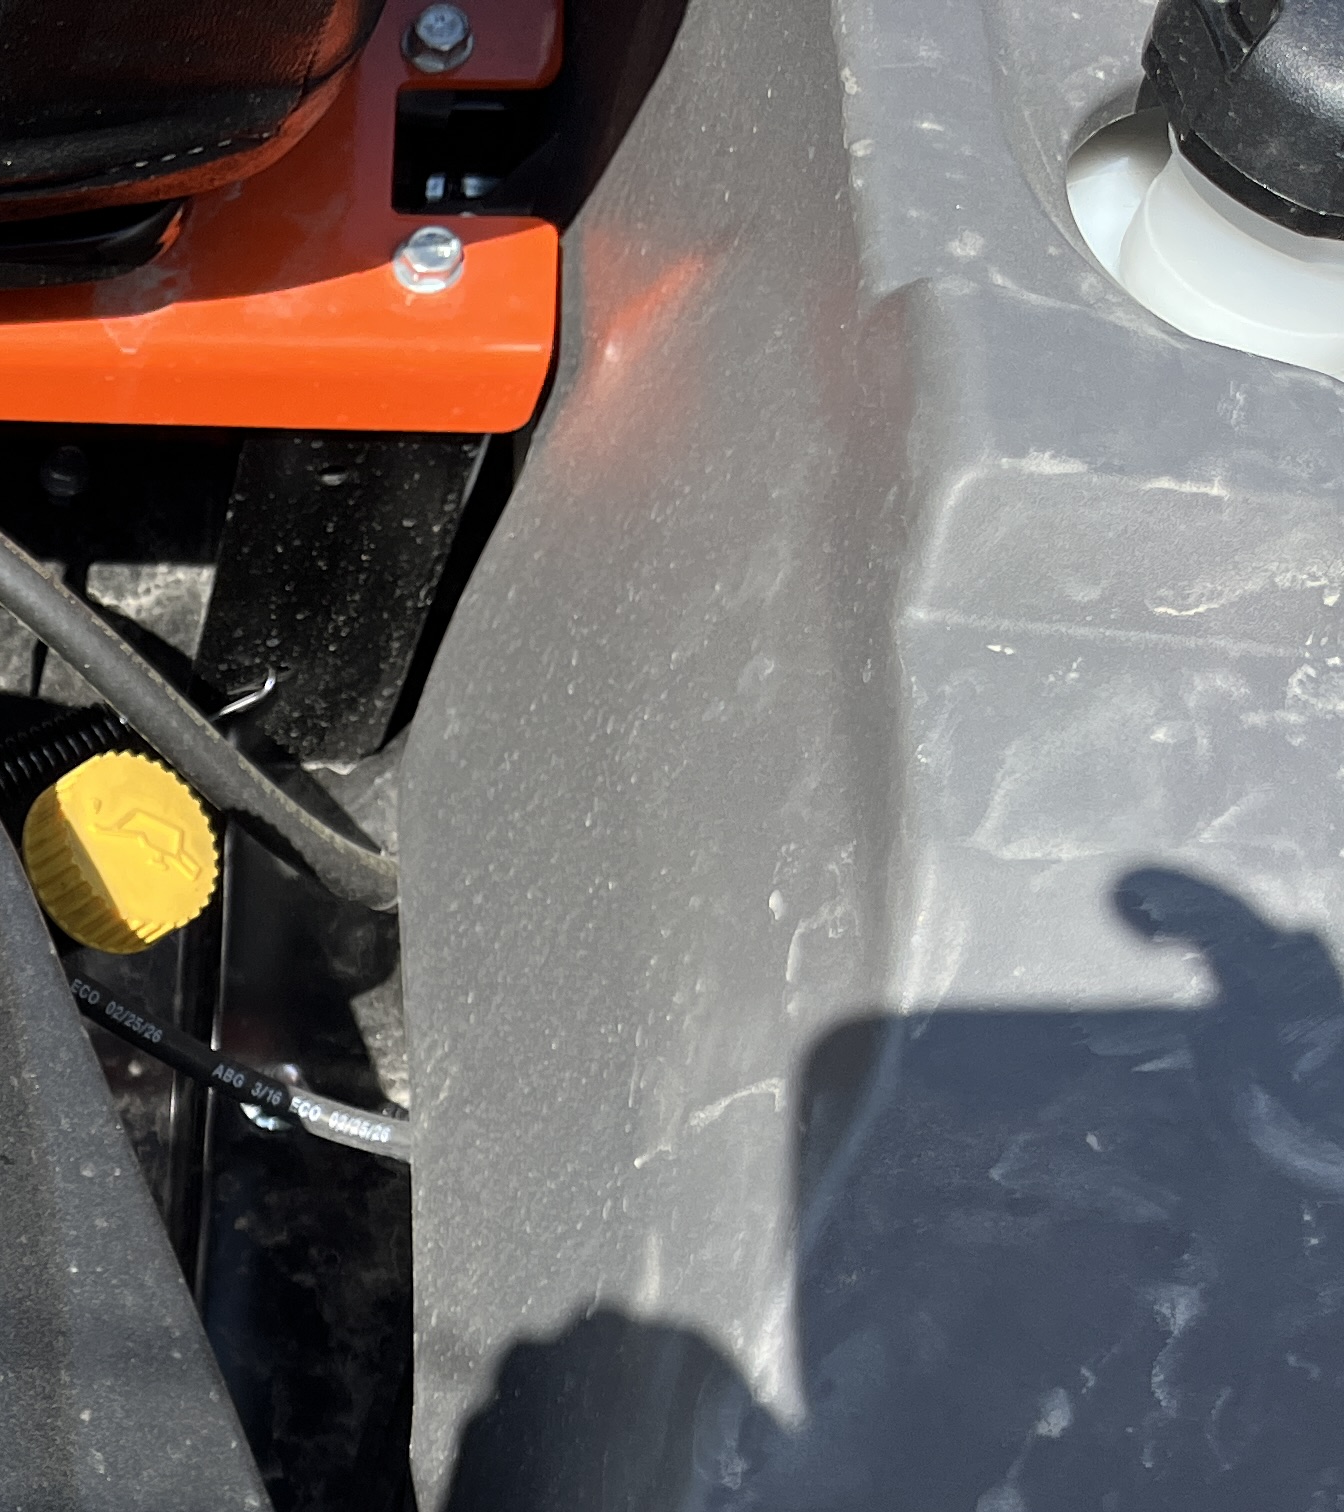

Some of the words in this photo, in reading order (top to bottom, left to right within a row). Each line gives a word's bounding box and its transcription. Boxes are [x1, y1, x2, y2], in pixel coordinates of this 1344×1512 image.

[70, 978, 100, 1005] ECO
[105, 1001, 163, 1043] 02/25/26
[212, 1063, 246, 1088] ABG
[251, 1082, 283, 1105] 3/16
[288, 1095, 321, 1122] ECO
